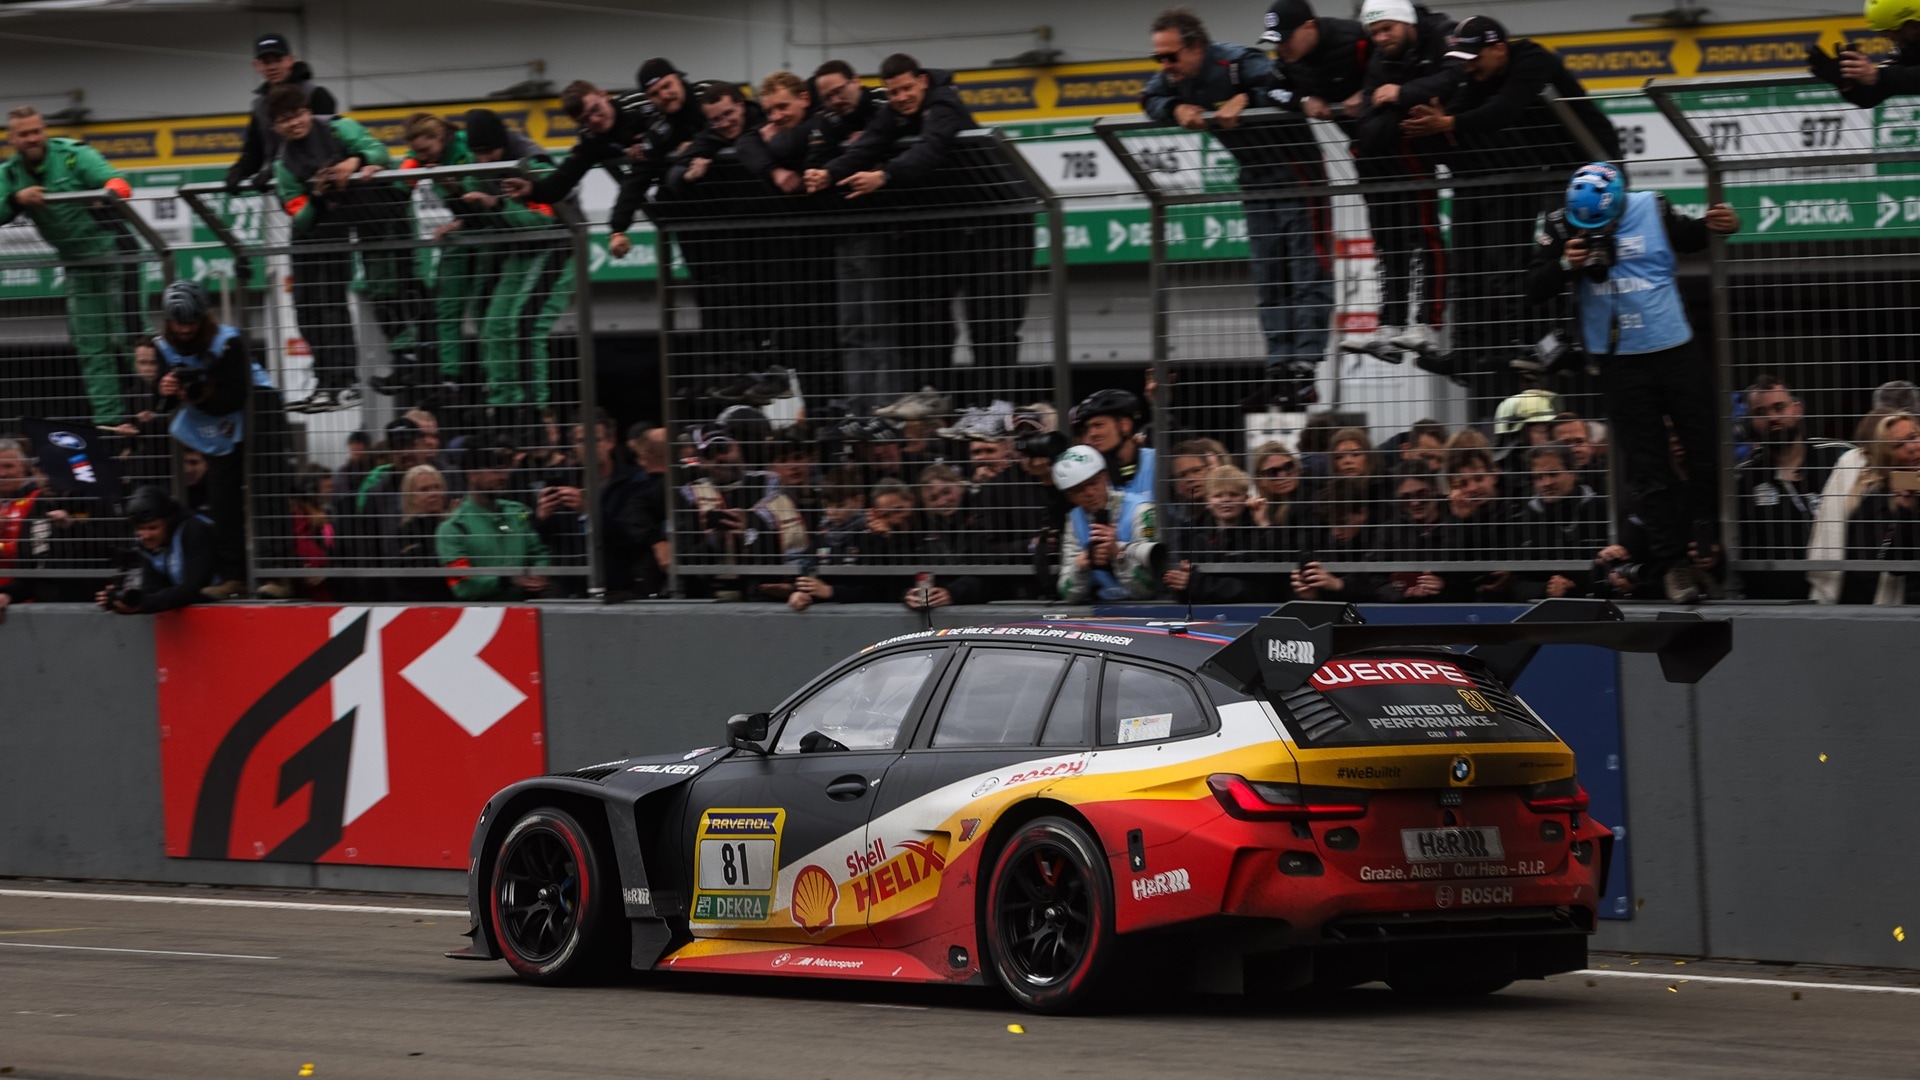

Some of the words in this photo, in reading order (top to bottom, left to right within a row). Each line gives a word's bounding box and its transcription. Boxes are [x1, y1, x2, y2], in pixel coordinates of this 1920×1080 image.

[1563, 50, 1665, 72] RAVENOL
[1706, 41, 1809, 64] RAVENOL
[1801, 116, 1844, 147] 977
[1785, 199, 1854, 226] DEKRA
[961, 627, 995, 636] WILDE
[1079, 631, 1134, 647] VERHAGEN
[1312, 660, 1469, 686] WEMPE
[1382, 703, 1445, 718] UNITED
[1446, 703, 1467, 715] BY
[1456, 688, 1496, 713] 81
[626, 764, 700, 776] FALKEN
[1004, 760, 1084, 786] BOSCH
[710, 816, 772, 832] RAVENOL
[720, 842, 751, 886] 81
[846, 837, 888, 878] Shell
[851, 839, 946, 913] HELIX
[1409, 863, 1443, 880] Alex!
[1453, 862, 1477, 878] Our
[1479, 861, 1508, 877] Hero
[1460, 886, 1513, 905] BOSCH
[716, 897, 764, 920] DEKRA
[813, 957, 864, 969] Motorsport
